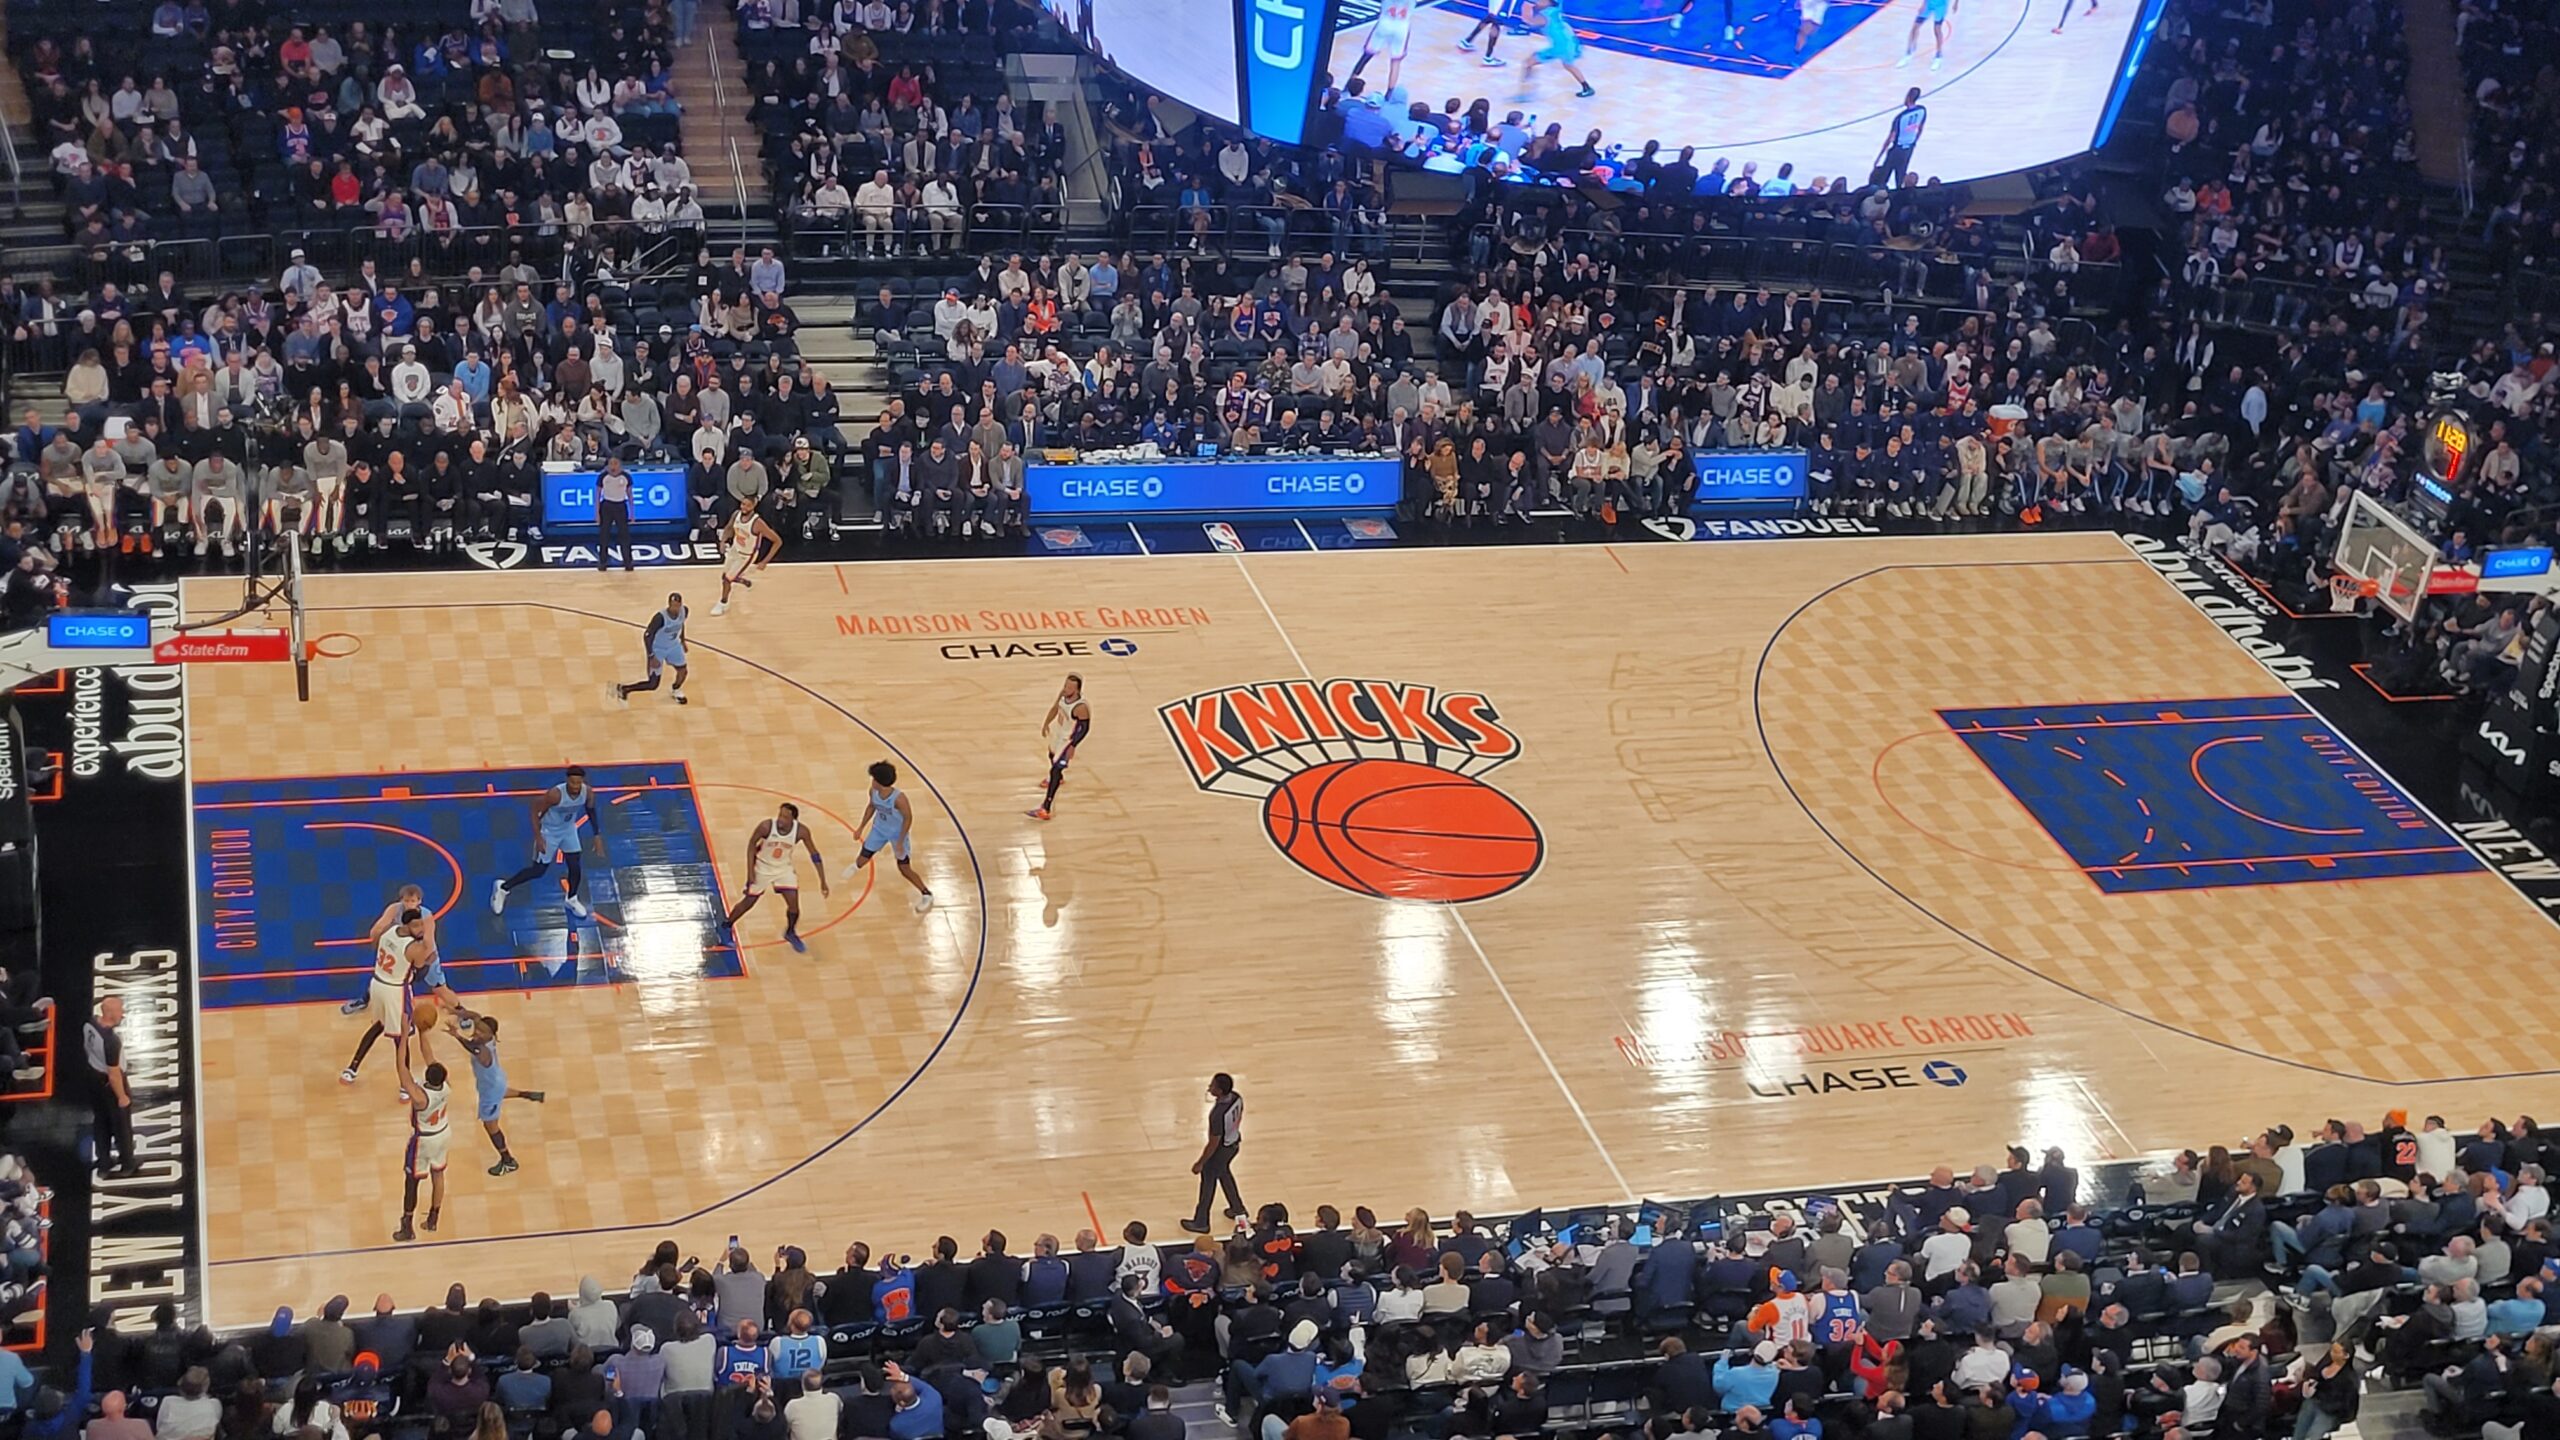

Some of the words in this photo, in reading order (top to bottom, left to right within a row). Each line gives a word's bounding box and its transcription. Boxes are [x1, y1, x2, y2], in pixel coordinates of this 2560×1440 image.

[1061, 479, 1140, 498] CHASE
[1266, 474, 1342, 494] CHASE
[1703, 468, 1771, 486] CHASE
[559, 487, 645, 507] CHE
[1703, 517, 1880, 537] FANDUEL
[2122, 532, 2216, 592] abu
[65, 626, 118, 637] CHASE
[835, 612, 973, 636] MADISON
[977, 608, 1092, 633] SQUARE
[1096, 604, 1213, 629] GARDEN
[939, 640, 1095, 661] CHASE
[109, 695, 184, 778] abu
[1160, 680, 1522, 785] KNICKS
[2301, 734, 2358, 765] CITY
[2343, 771, 2429, 829] EDITION
[210, 829, 255, 899] EDITION
[214, 909, 257, 949] CITY
[376, 949, 397, 975] 32
[1902, 1010, 2036, 1046] GARDEN
[2395, 1141, 2417, 1165] 22
[1828, 1318, 1857, 1342] 32
[788, 1348, 812, 1369] 12
